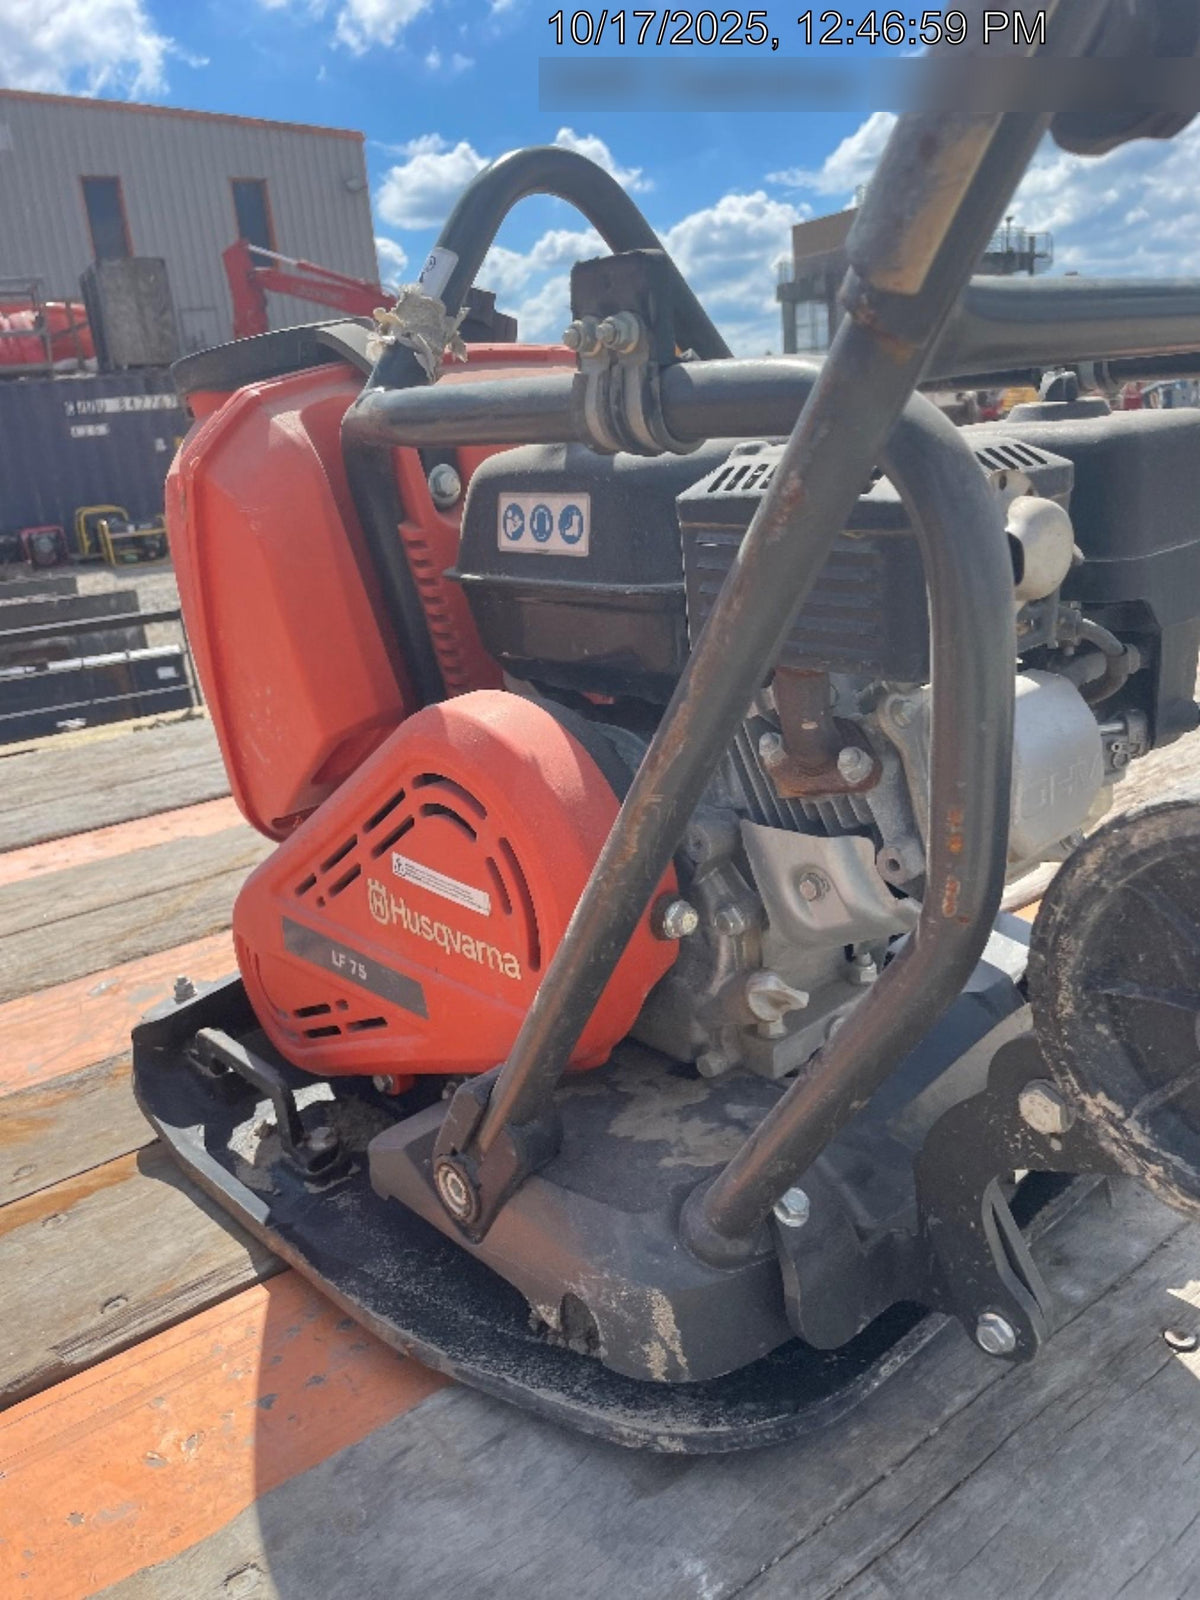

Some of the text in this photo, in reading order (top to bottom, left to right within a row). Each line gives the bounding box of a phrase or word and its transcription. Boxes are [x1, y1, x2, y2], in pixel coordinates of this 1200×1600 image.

[331, 949, 368, 981] LF 75
[390, 894, 521, 981] Husqvarna
